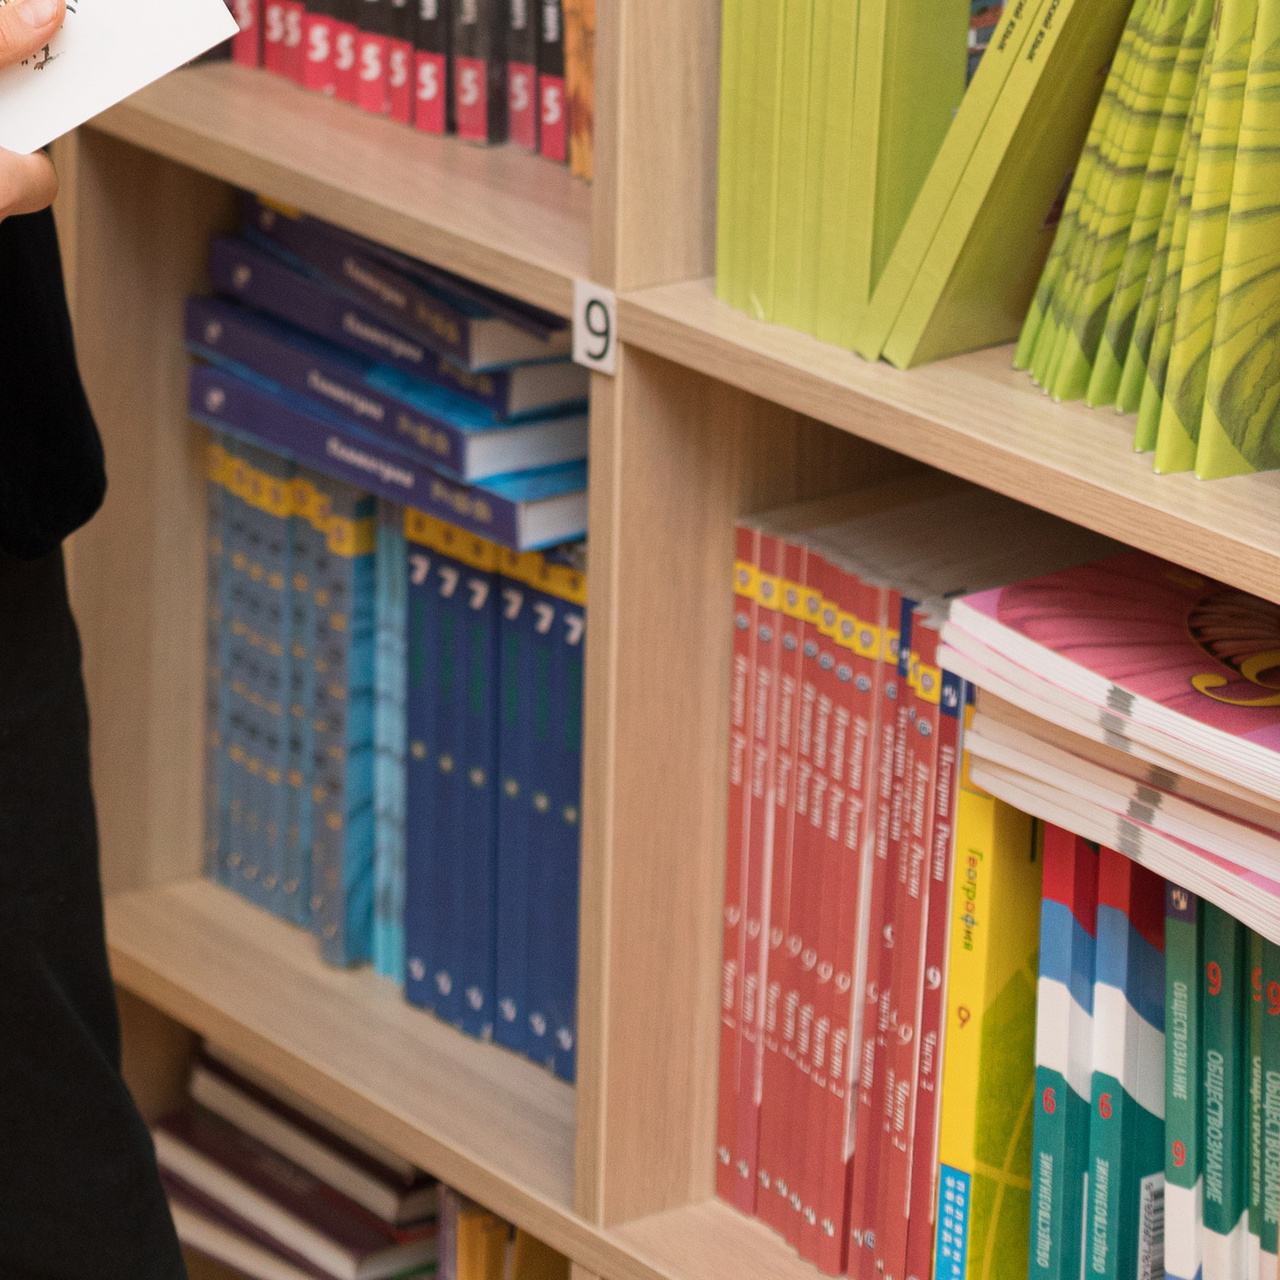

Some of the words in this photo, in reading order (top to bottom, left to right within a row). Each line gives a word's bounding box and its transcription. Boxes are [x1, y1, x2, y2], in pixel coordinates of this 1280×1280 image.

[585, 299, 610, 362] 9
[410, 554, 431, 586] 7
[467, 579, 490, 611] 7
[502, 588, 524, 621] 7
[912, 759, 931, 840] История
[935, 743, 956, 819] История
[907, 840, 926, 901] России
[932, 821, 952, 883] России
[960, 848, 984, 952] География
[925, 965, 942, 991] 9
[1206, 961, 1222, 996] 9
[1265, 980, 1280, 1016] 9
[898, 1021, 915, 1046] 9
[921, 1030, 938, 1077] Часть
[1172, 981, 1189, 1101] ОБЩЕСТВОЗНАНИЕ
[892, 1079, 911, 1134] Часть
[1042, 1086, 1057, 1115] 6
[1098, 1092, 1113, 1121] 6
[1205, 1048, 1224, 1207] ОБЩЕСТВОЗНАНИЕ
[1172, 1140, 1187, 1167] 9
[941, 1176, 956, 1258] ЗВЕЗДА
[951, 1180, 966, 1280] ПОЛЯРНА
[1036, 1151, 1054, 1269] ОБЩЕСТВОЗНАНИЕ
[1092, 1157, 1110, 1275] ОБЩЕСТВОЗНАНИЕ
